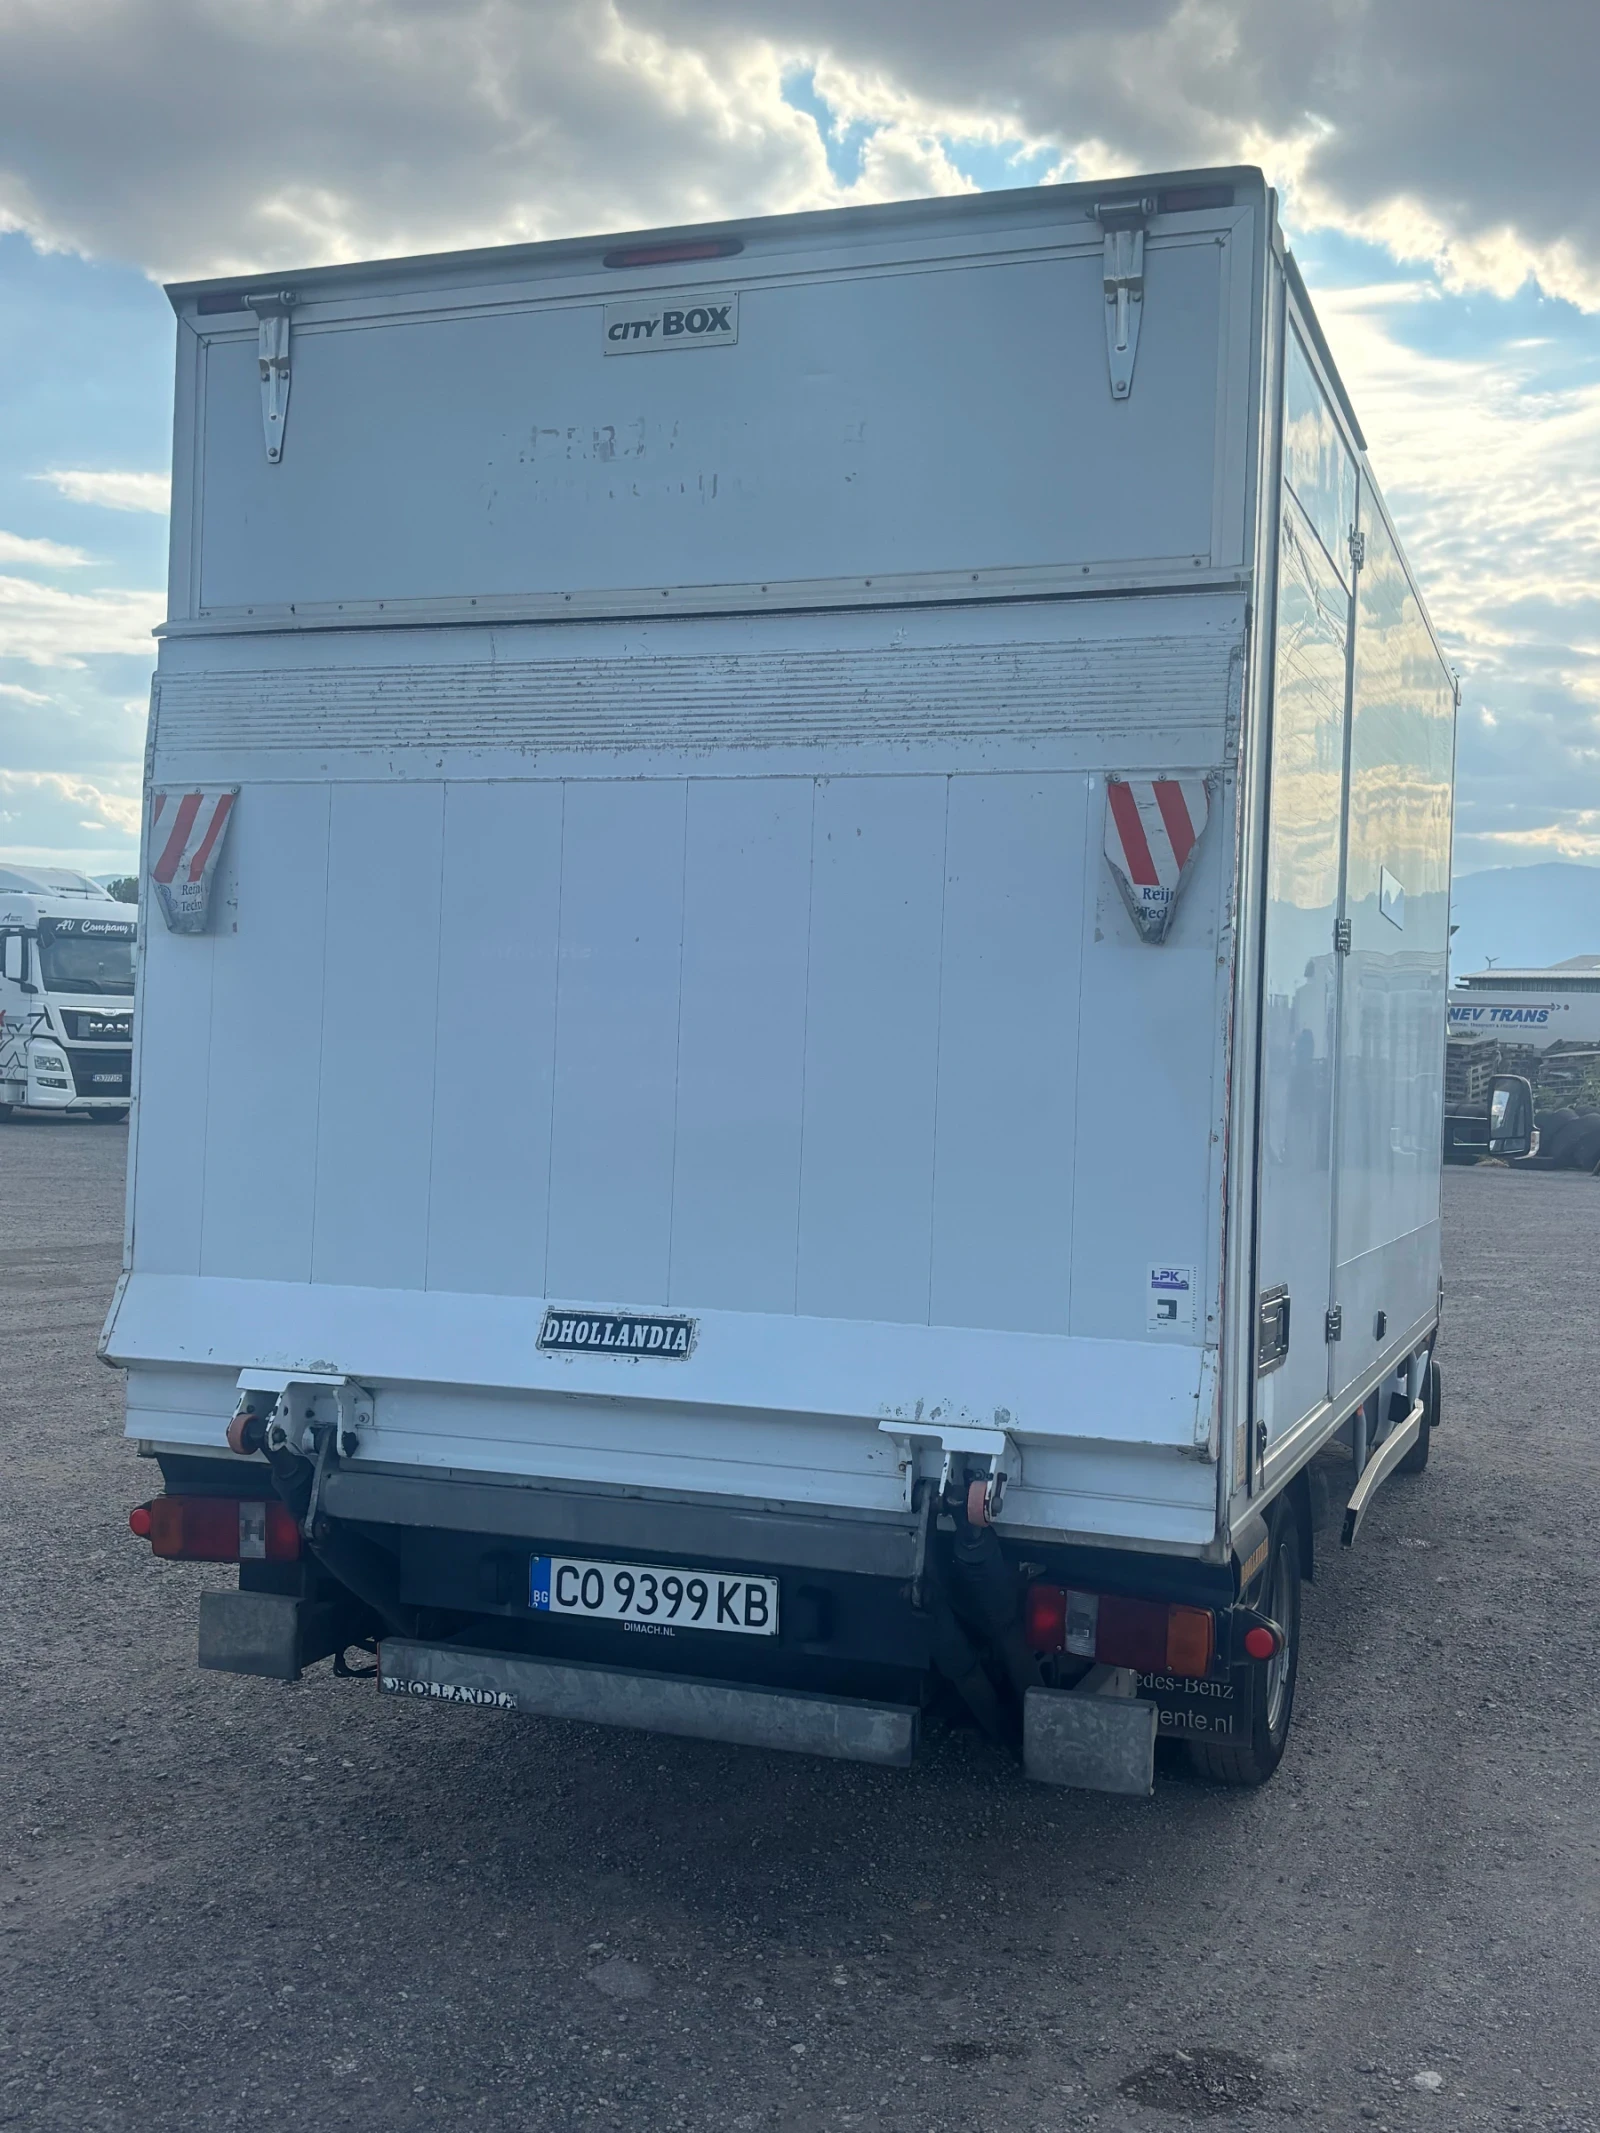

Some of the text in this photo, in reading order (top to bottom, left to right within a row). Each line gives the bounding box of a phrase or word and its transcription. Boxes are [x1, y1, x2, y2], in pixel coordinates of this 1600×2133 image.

[608, 306, 732, 341] CITY BOX
[55, 919, 76, 931] AV
[81, 919, 129, 935] Company
[1449, 1007, 1550, 1023] NEV TRANS
[90, 1022, 129, 1033] MAN
[1151, 1270, 1180, 1282] LPK
[543, 1319, 687, 1350] DHOLLANDIA
[533, 1590, 548, 1603] BG
[613, 1571, 709, 1621] 9399
[716, 1581, 769, 1627] KB
[623, 1622, 676, 1637] DIMACH.NL
[1136, 1672, 1235, 1700] edes-Benz
[1157, 1709, 1234, 1735] ente.nl
